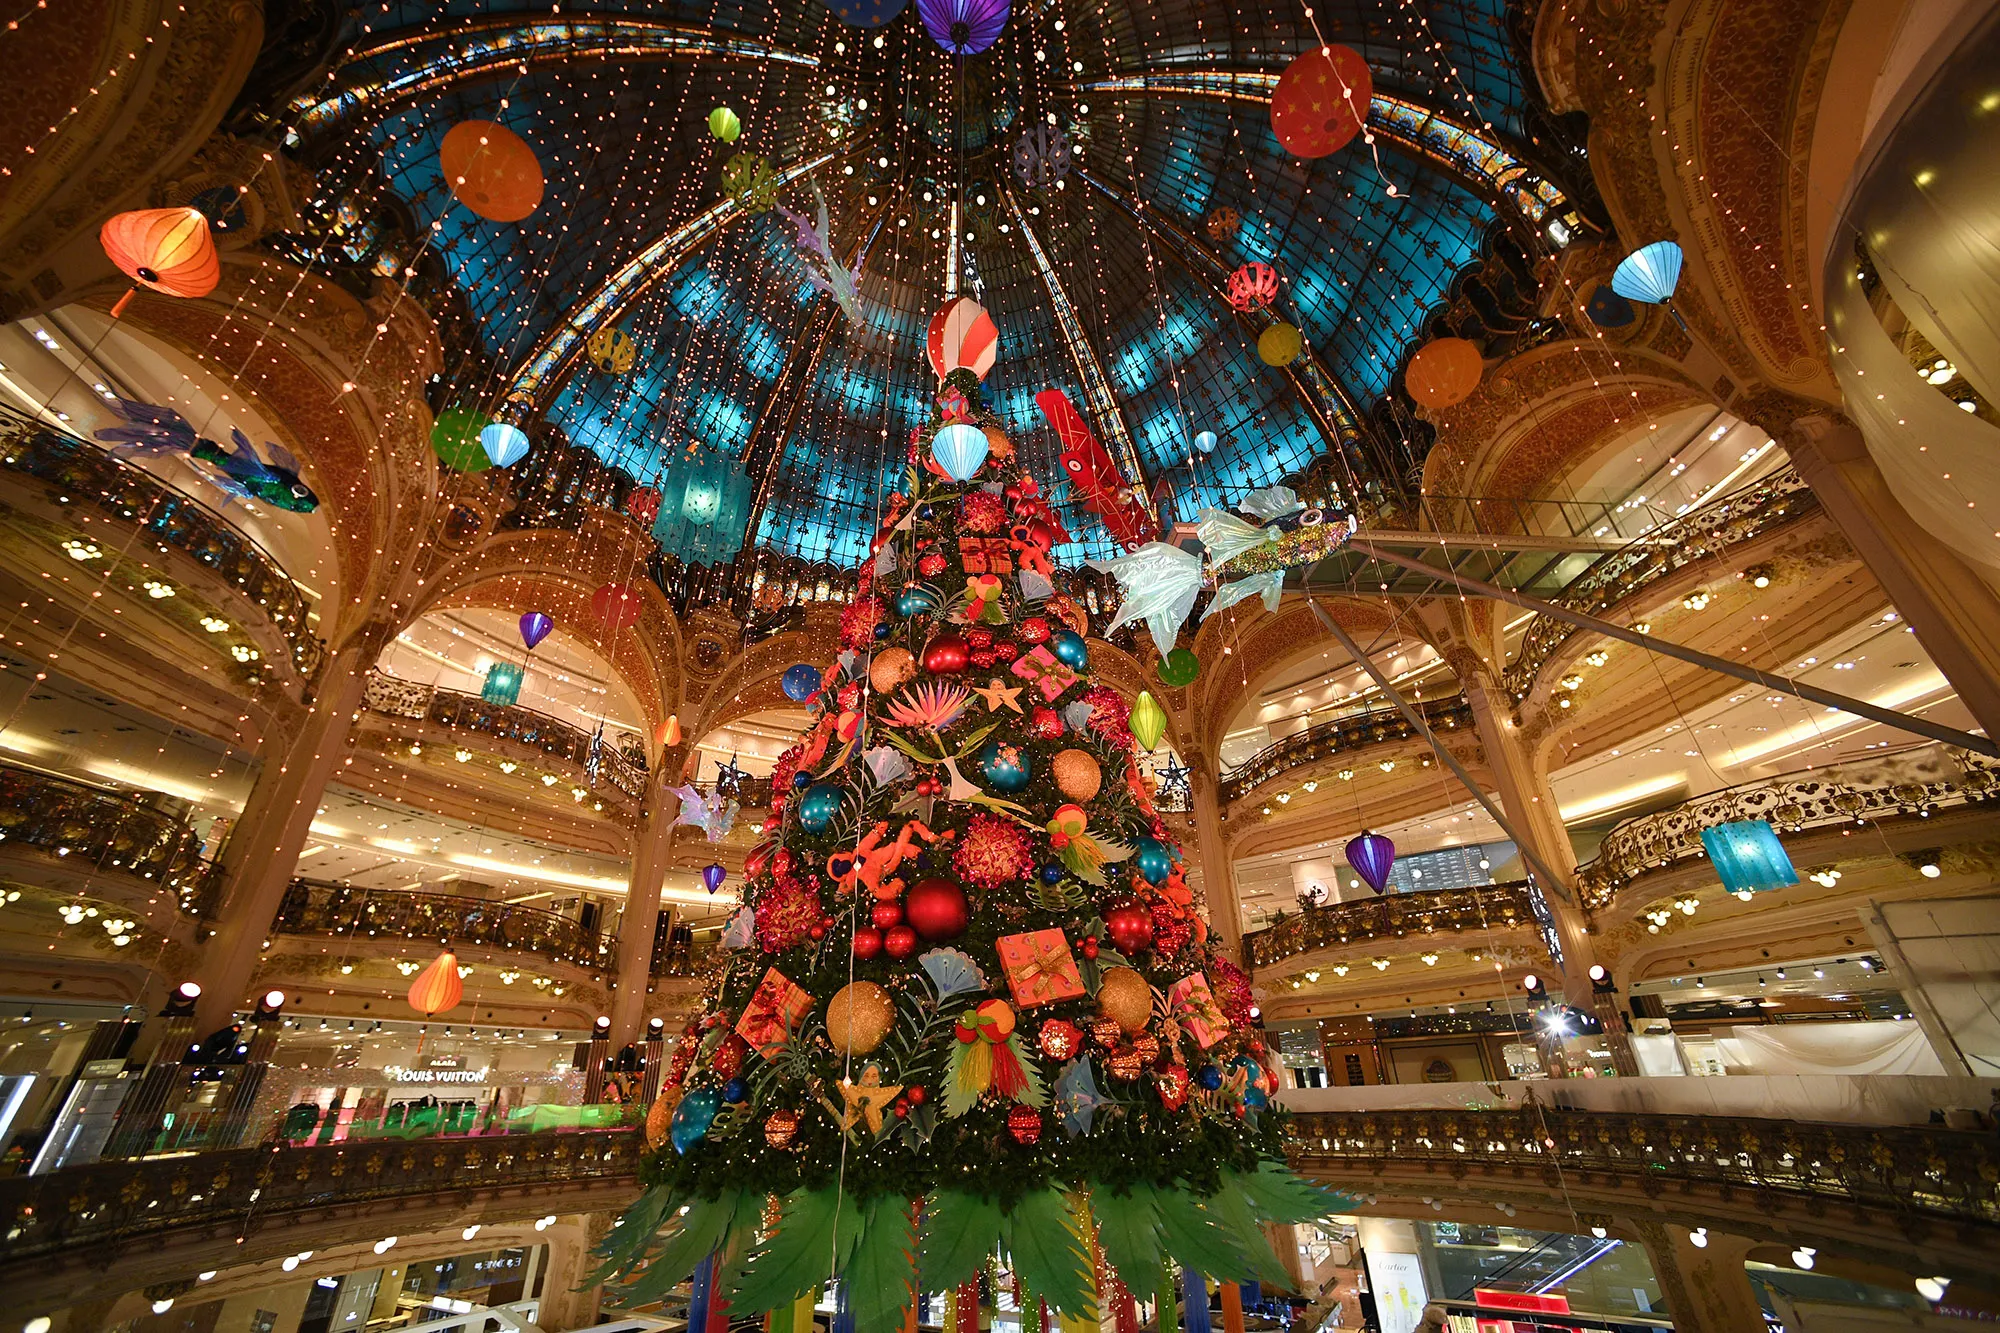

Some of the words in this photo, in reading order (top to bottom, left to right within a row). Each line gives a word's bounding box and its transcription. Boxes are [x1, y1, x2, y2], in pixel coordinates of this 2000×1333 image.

[397, 1070, 434, 1082] LOUIS
[435, 1070, 486, 1083] VUITTON
[1378, 1260, 1409, 1272] Cartier
